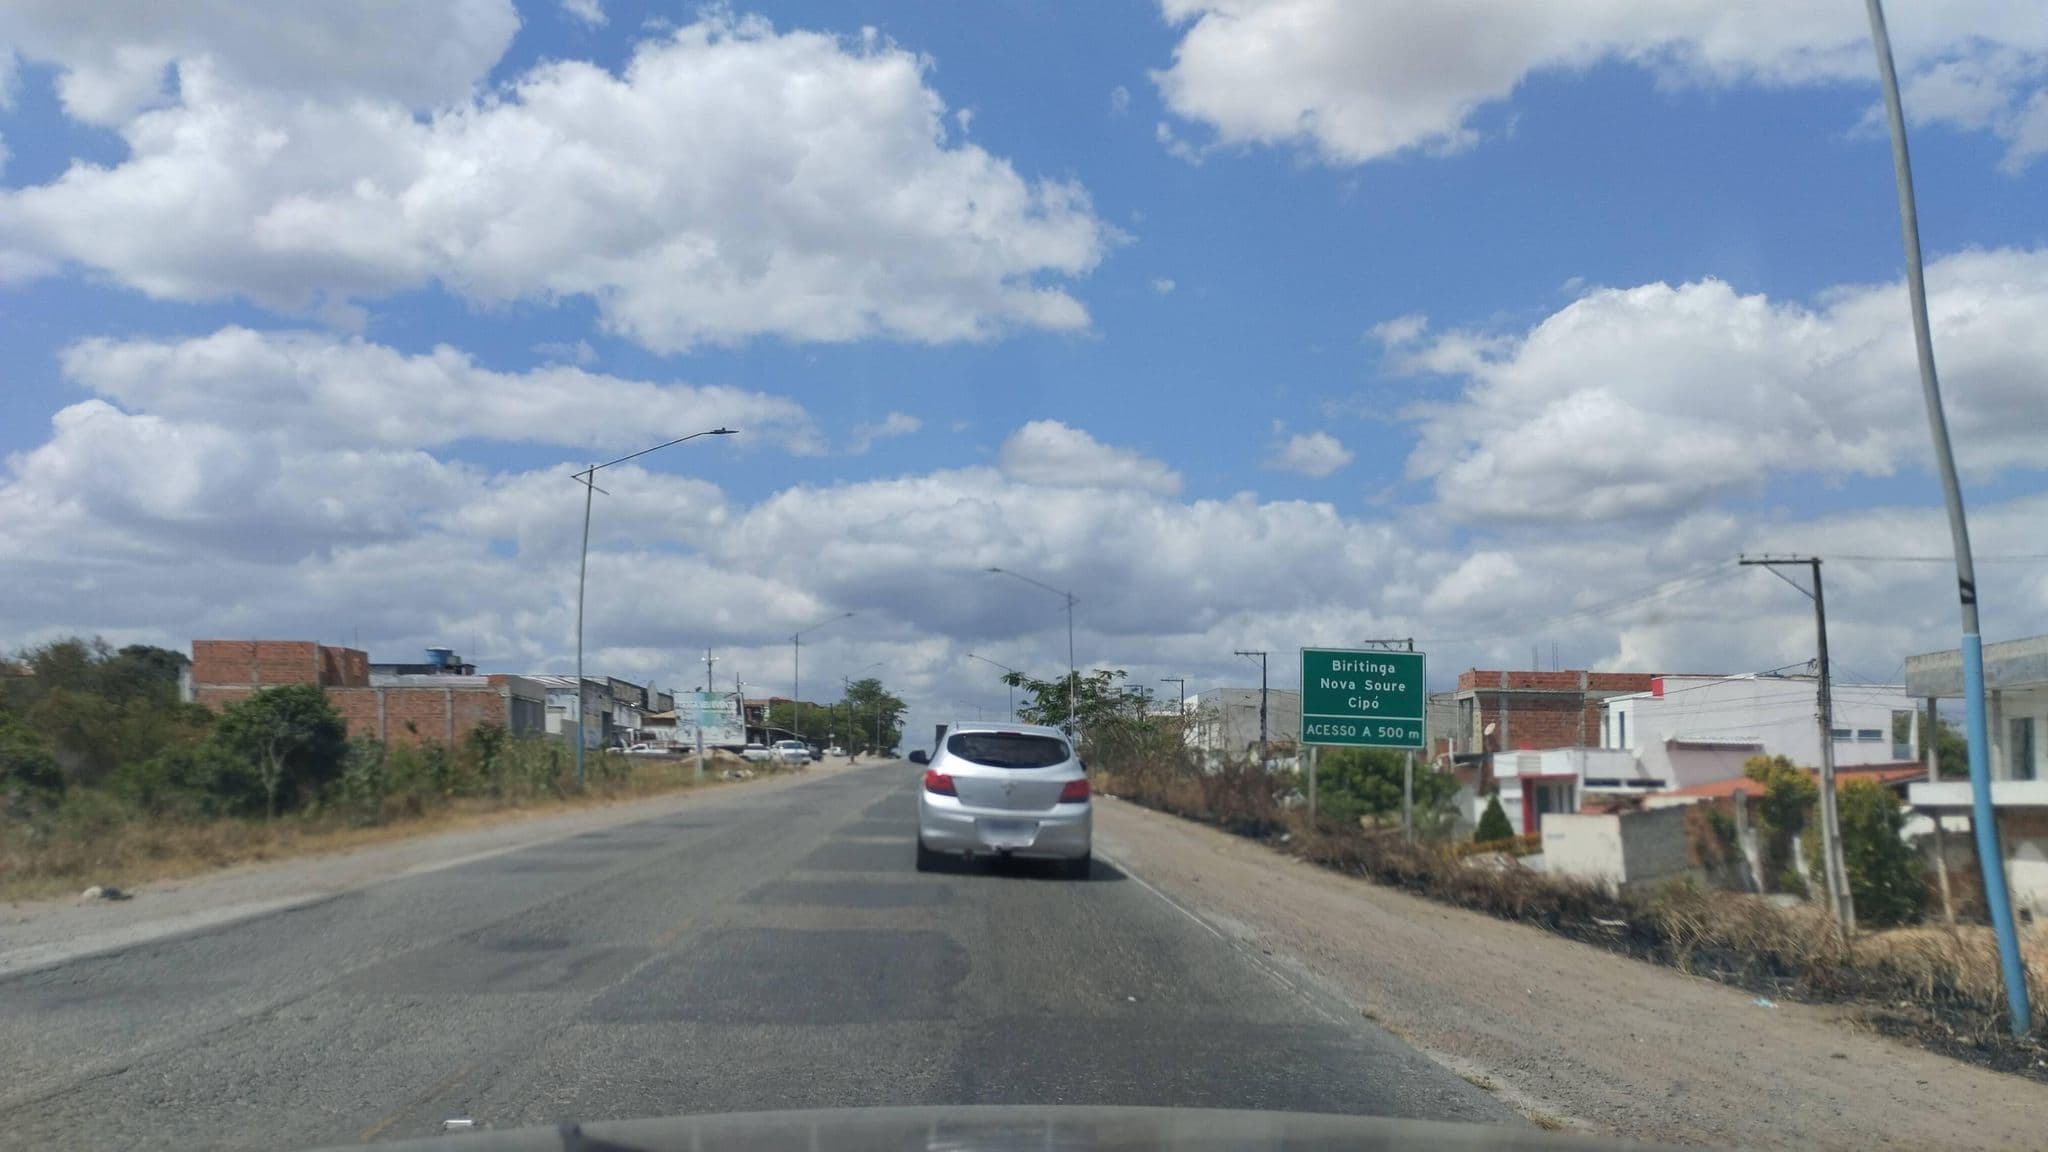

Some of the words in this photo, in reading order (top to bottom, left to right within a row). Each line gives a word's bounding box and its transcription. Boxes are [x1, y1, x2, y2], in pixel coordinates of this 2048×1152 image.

[1332, 660, 1395, 676] Biritinga
[1320, 678, 1356, 690] Nova
[1364, 679, 1406, 692] Soure
[1348, 695, 1379, 710] Cipó
[1306, 724, 1356, 736] ACESSO
[1362, 726, 1371, 738] A
[1378, 726, 1403, 738] 500
[1409, 731, 1419, 739] m
